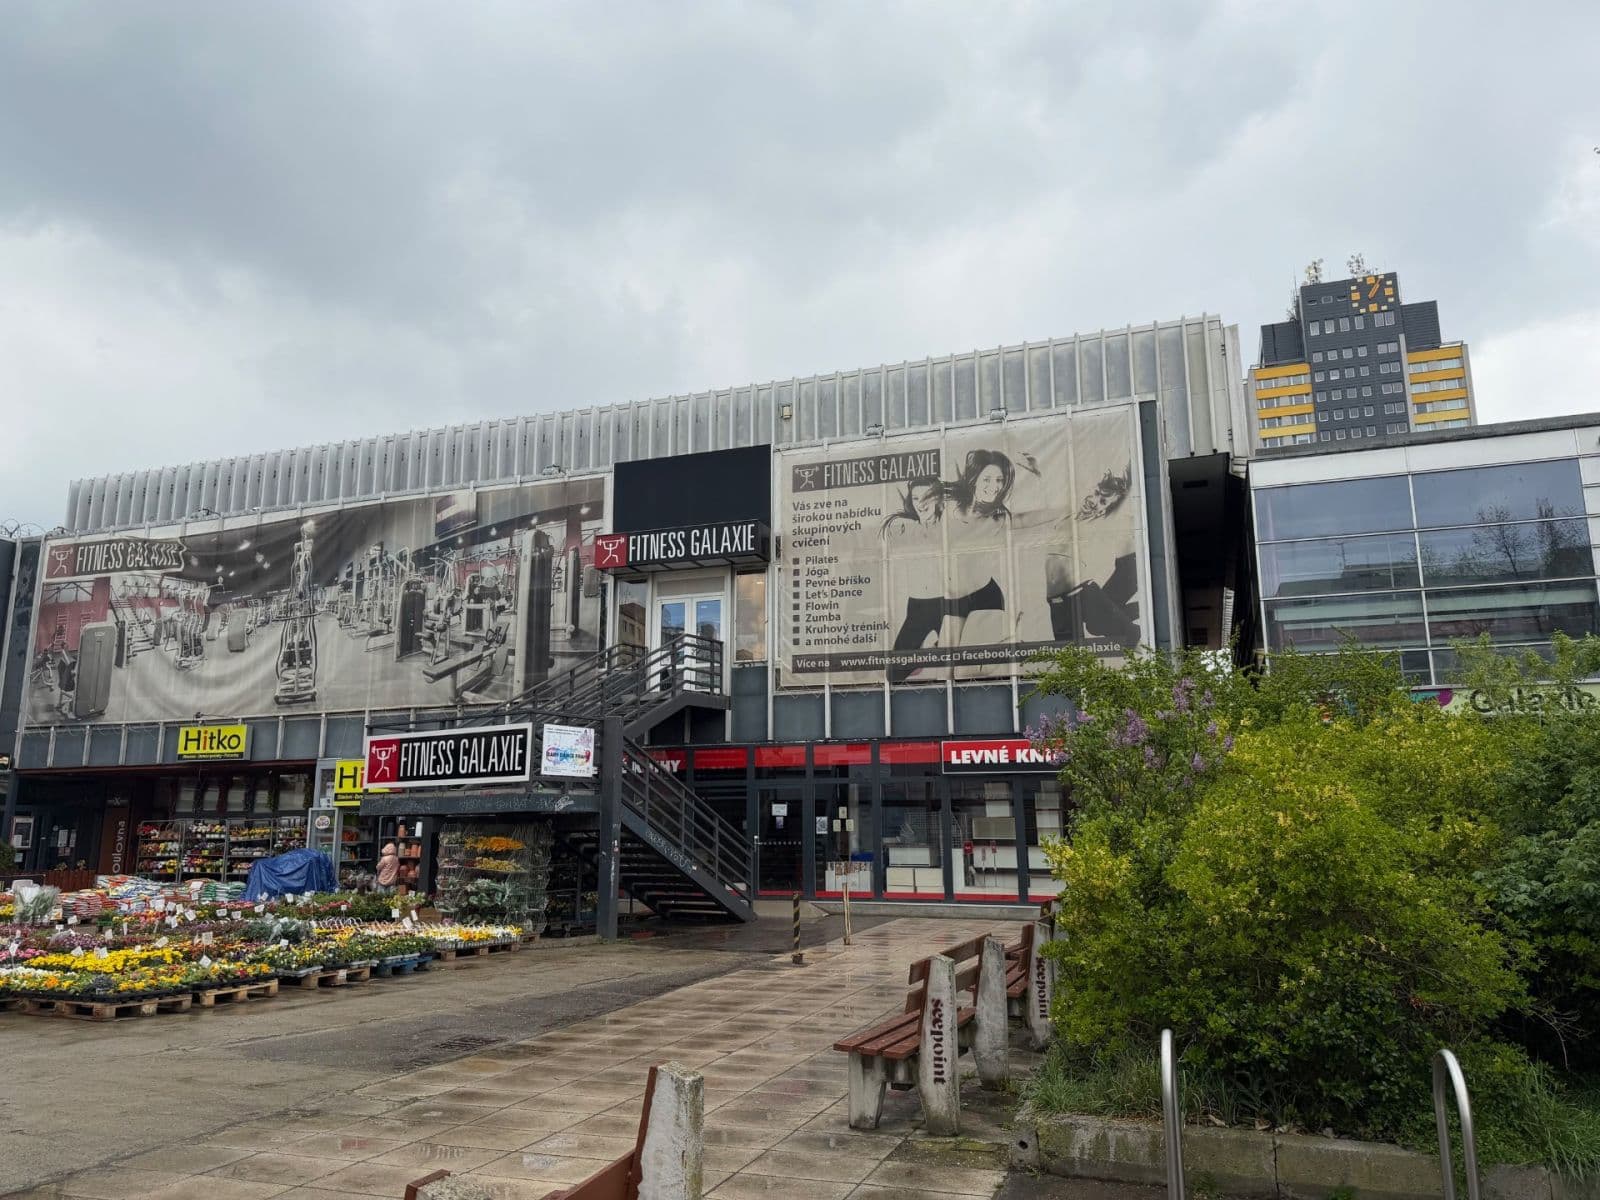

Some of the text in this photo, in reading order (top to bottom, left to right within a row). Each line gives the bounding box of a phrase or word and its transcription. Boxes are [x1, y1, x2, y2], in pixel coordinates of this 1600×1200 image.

[824, 452, 937, 487] FITNESS GALAXIE
[792, 499, 848, 511] Vás zve na
[792, 506, 882, 523] širokou nabídku
[792, 521, 862, 537] skupinových
[628, 523, 756, 563] FITNESS GALAXIE
[792, 535, 830, 549] cvičení
[76, 541, 180, 573] FITNESS GALAXIE
[805, 555, 839, 566] Pilates
[805, 567, 829, 578] Jóga
[805, 578, 837, 588] Pevné
[830, 588, 863, 598] Dance
[805, 601, 839, 611] Flowin
[805, 613, 841, 623] Zumba
[805, 620, 890, 635] Kruhový trénink
[813, 635, 850, 645] mnohé
[851, 632, 877, 644] další
[796, 658, 816, 669] Více
[817, 660, 831, 668] na
[840, 653, 951, 666] www.fitnessgalaxie.cz
[183, 728, 241, 751] Hitko
[400, 734, 525, 777] FITNESS GALAXIE
[951, 744, 1009, 764] LEVNÉ
[1036, 957, 1048, 1019] seepoint
[930, 998, 947, 1085] seepoint
